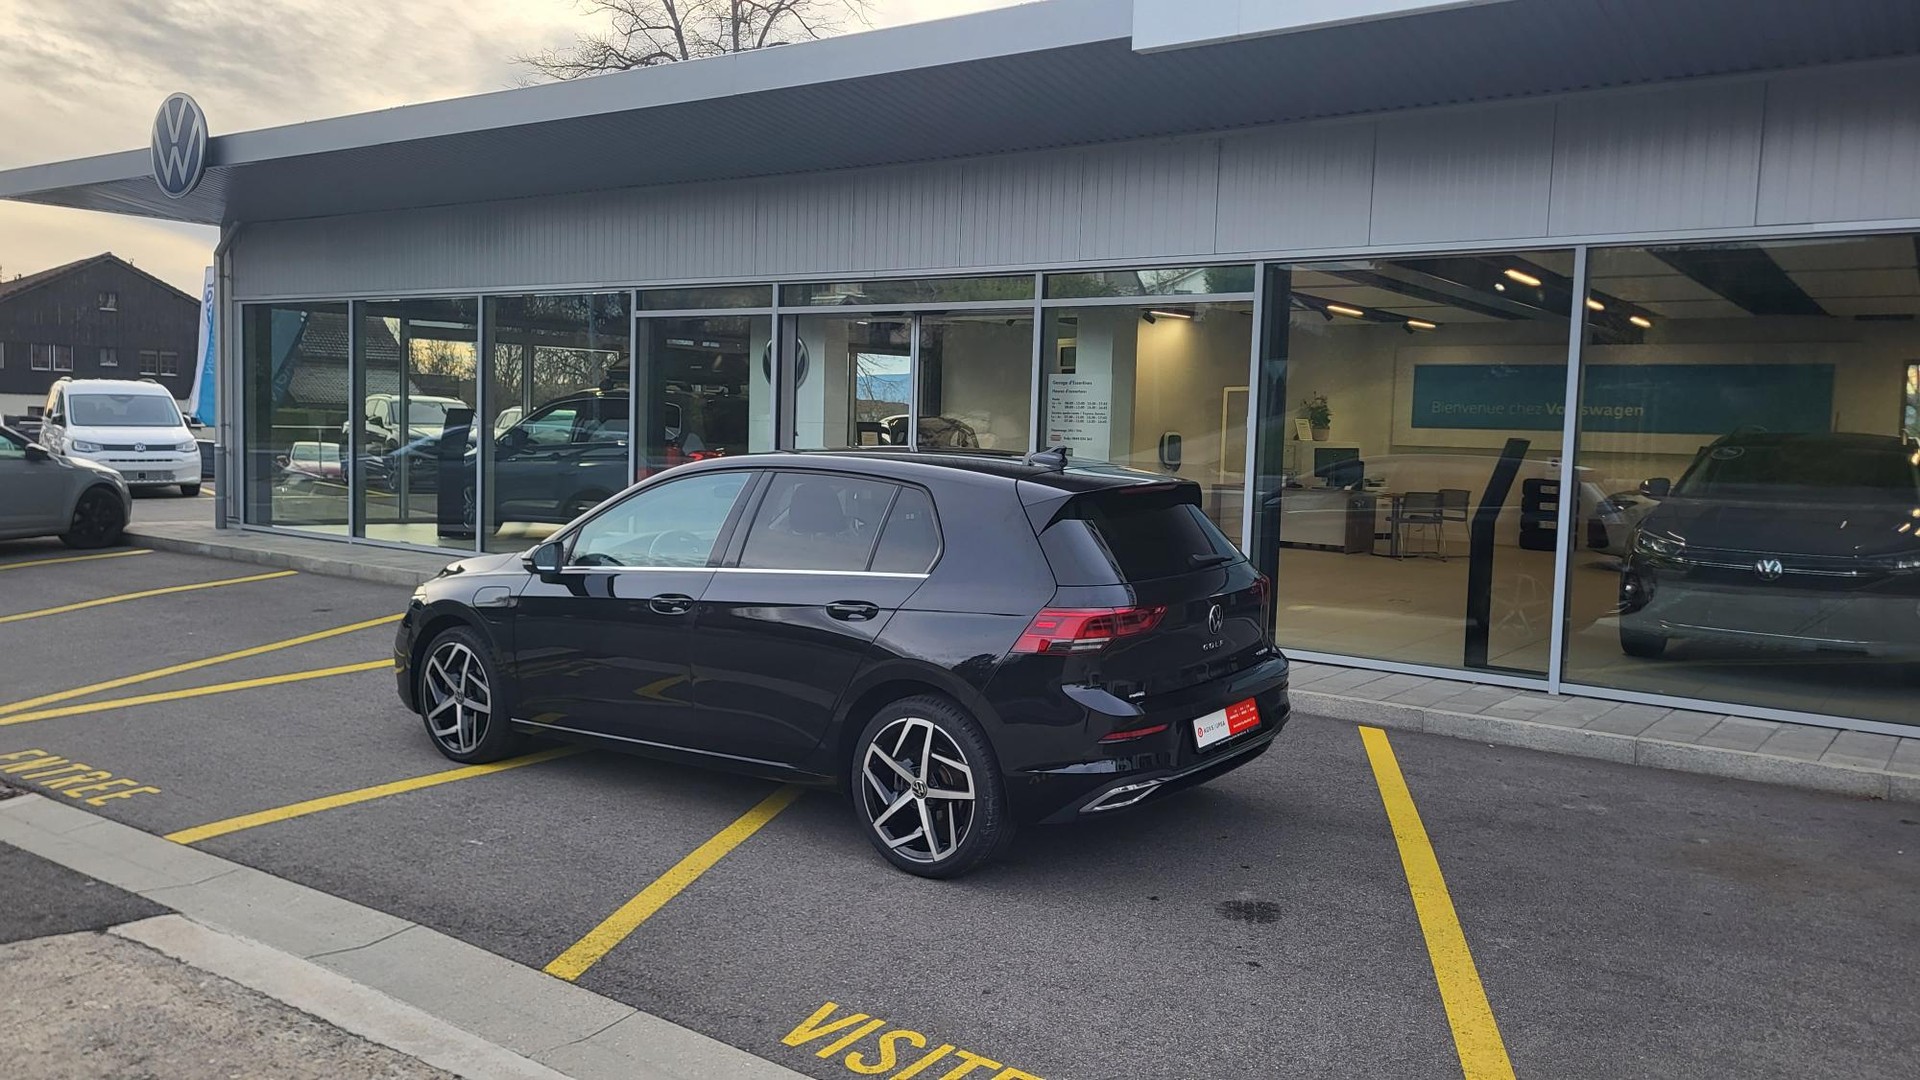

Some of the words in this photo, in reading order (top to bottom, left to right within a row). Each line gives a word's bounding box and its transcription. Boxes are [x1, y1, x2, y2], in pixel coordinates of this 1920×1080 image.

[1431, 400, 1504, 416] Bienvenue
[1509, 401, 1542, 416] chez
[1545, 402, 1645, 420] Voswagen
[1202, 640, 1224, 651] GOLF
[780, 1001, 1046, 1080] VISIT
